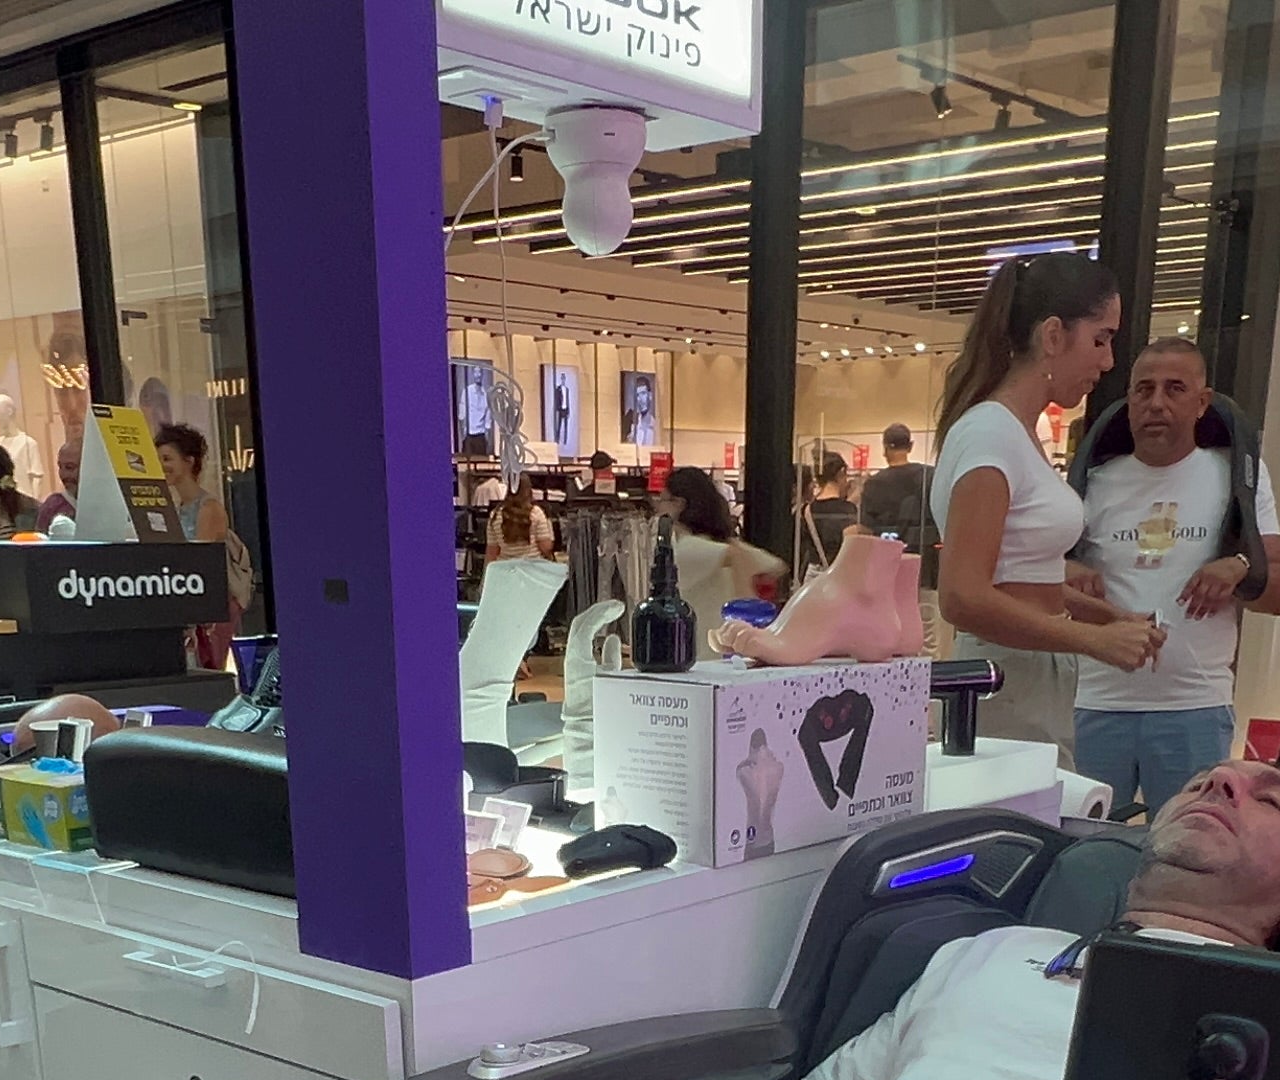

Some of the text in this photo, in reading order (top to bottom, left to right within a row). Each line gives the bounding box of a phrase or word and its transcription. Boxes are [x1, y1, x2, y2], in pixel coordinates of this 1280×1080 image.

[626, 23, 701, 67] פינוק
[1112, 526, 1207, 542] STAY GOLD
[58, 566, 205, 606] dynamica
[657, 696, 689, 709] מעסה
[885, 771, 914, 789] מעסה
[848, 790, 914, 817] צוואר וכתפיים
